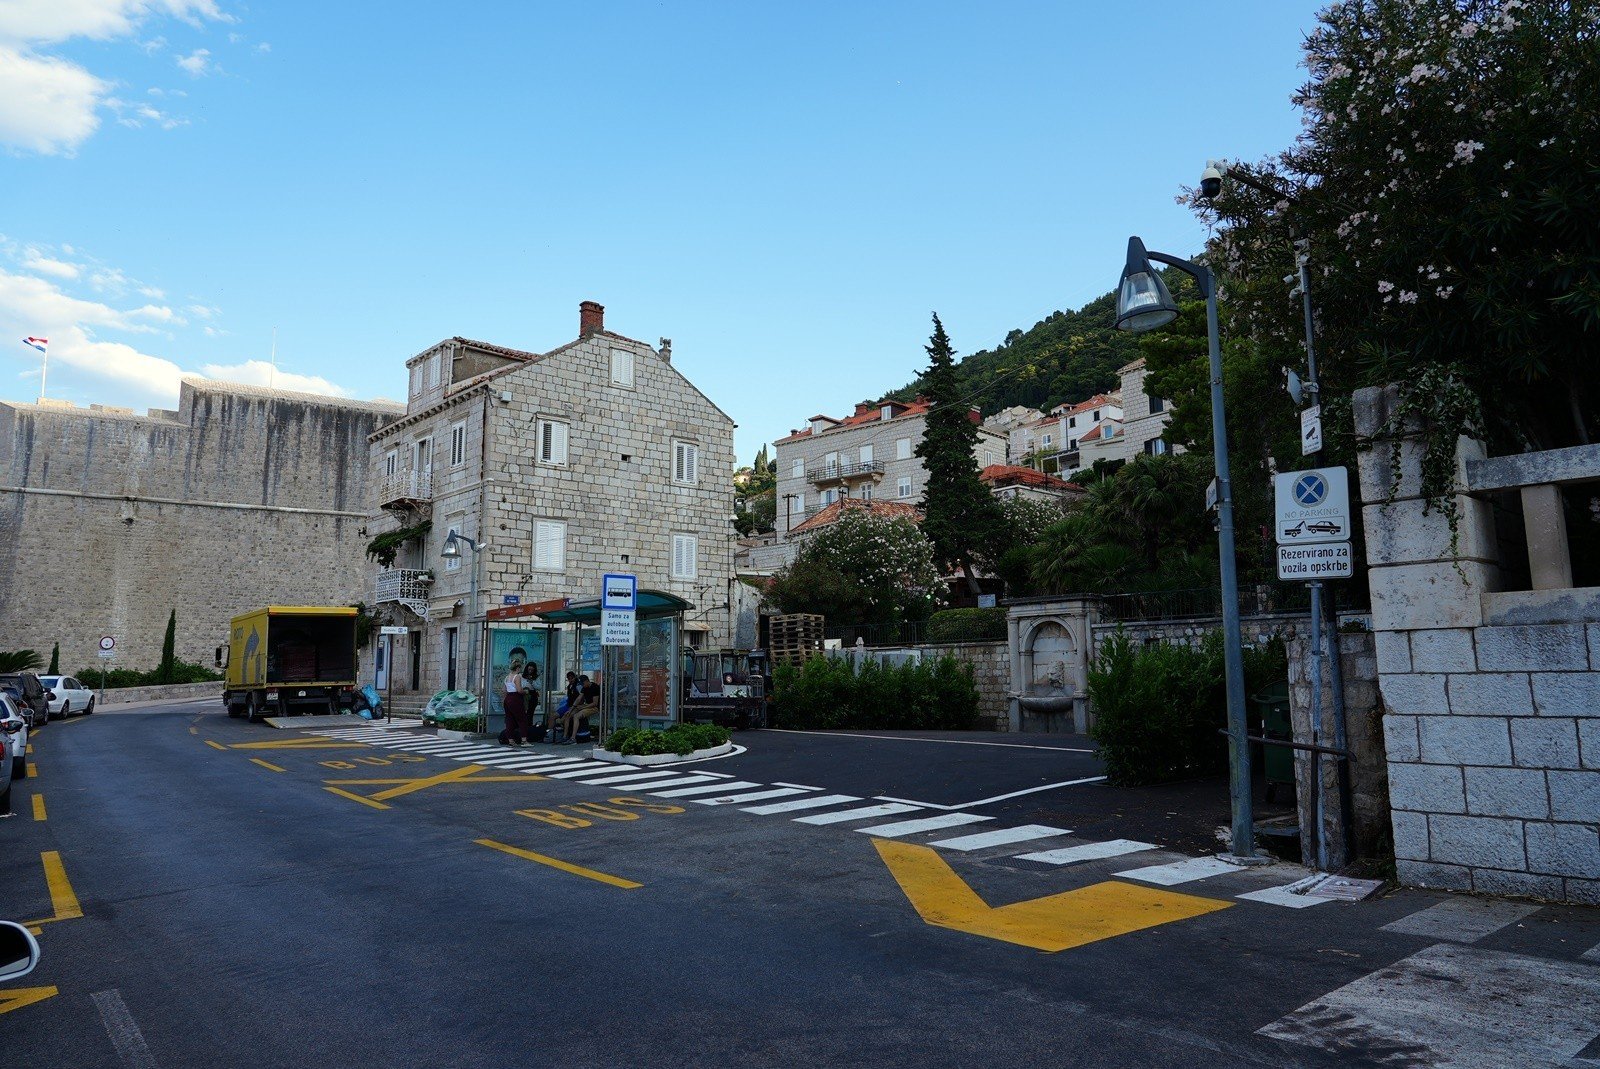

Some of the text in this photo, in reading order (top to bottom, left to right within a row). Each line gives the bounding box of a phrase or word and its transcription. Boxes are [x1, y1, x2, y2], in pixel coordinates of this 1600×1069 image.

[1284, 507, 1339, 519] NO PARKING
[1280, 547, 1348, 560] Rezervirano za
[1282, 560, 1348, 574] vozila opskrbe
[317, 753, 427, 770] BUS
[511, 796, 687, 830] BUS
